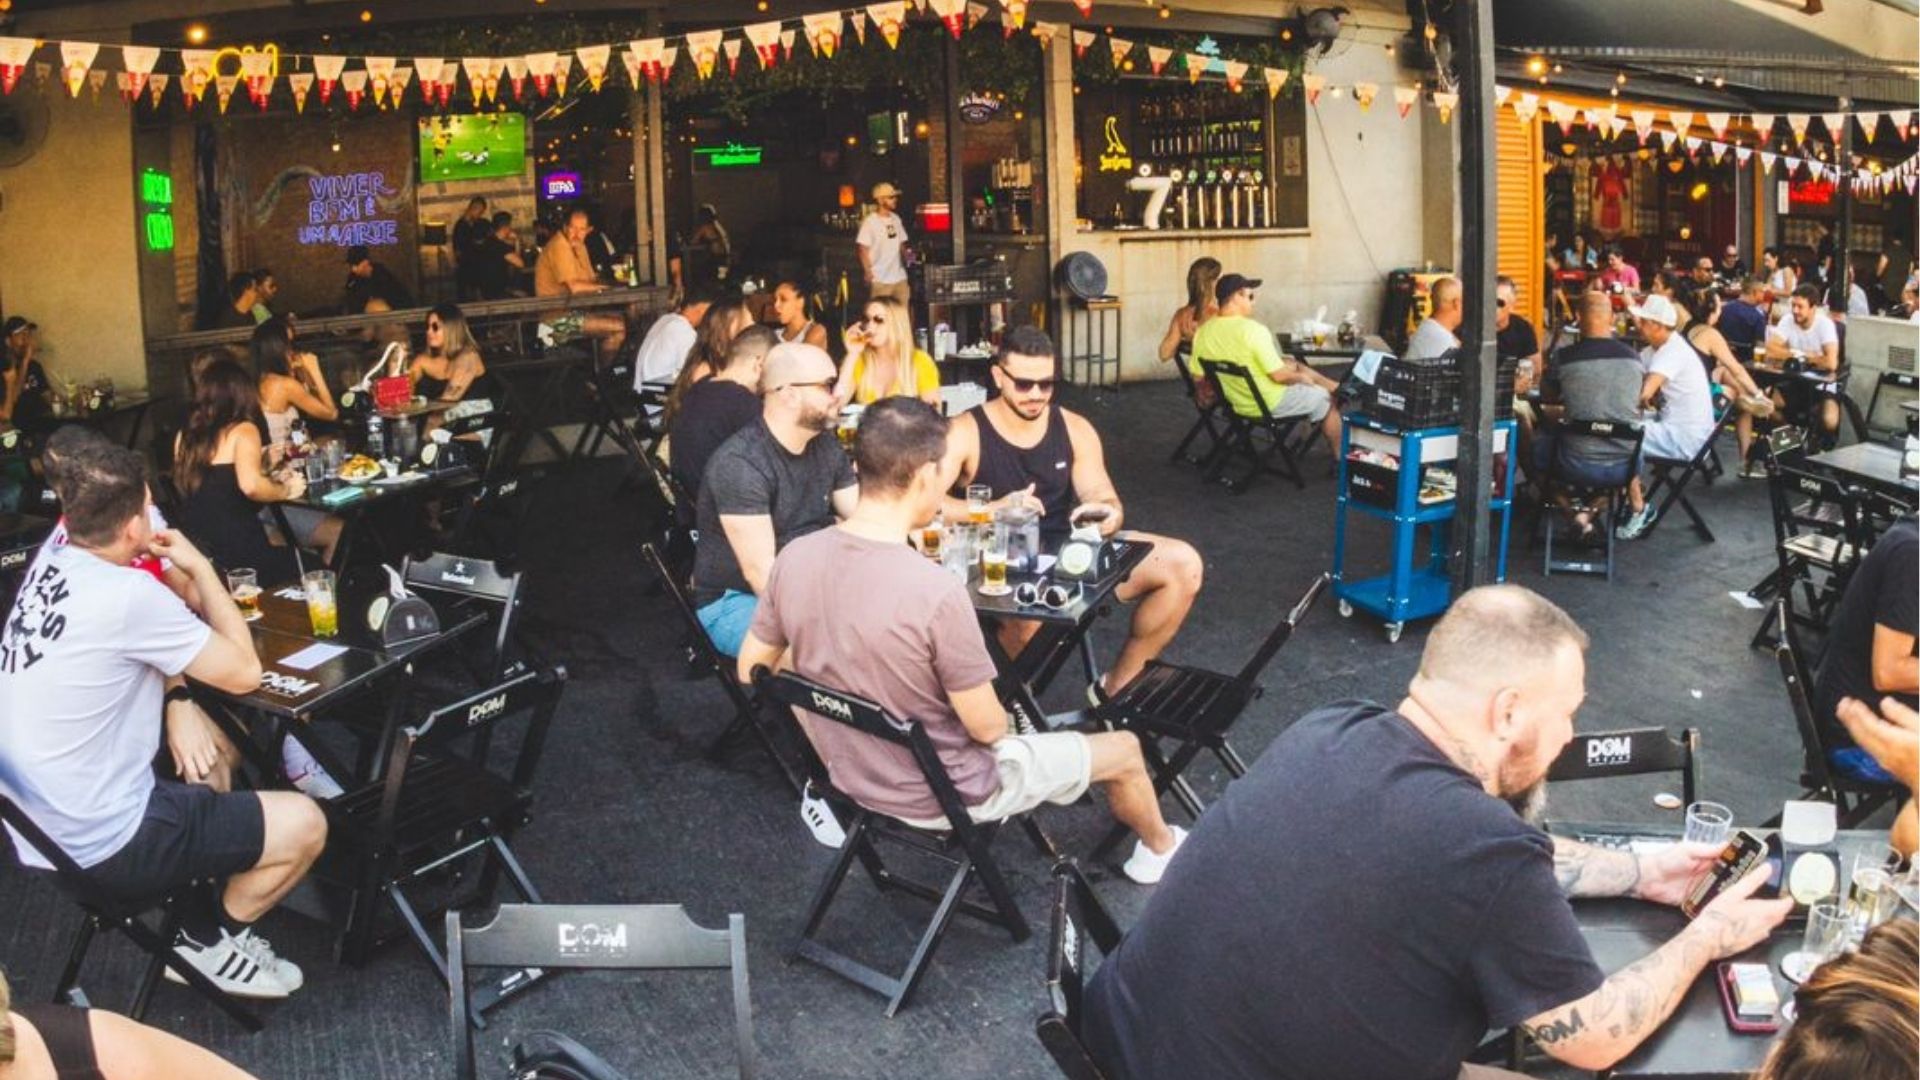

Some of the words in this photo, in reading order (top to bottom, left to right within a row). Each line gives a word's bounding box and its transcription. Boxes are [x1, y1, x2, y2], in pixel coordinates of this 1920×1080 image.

[309, 172, 397, 200] VIVER
[1125, 176, 1173, 230] 7
[469, 693, 506, 720] DOM
[811, 690, 852, 717] DOM
[1587, 736, 1631, 757] DOM
[559, 922, 627, 947] DOM
